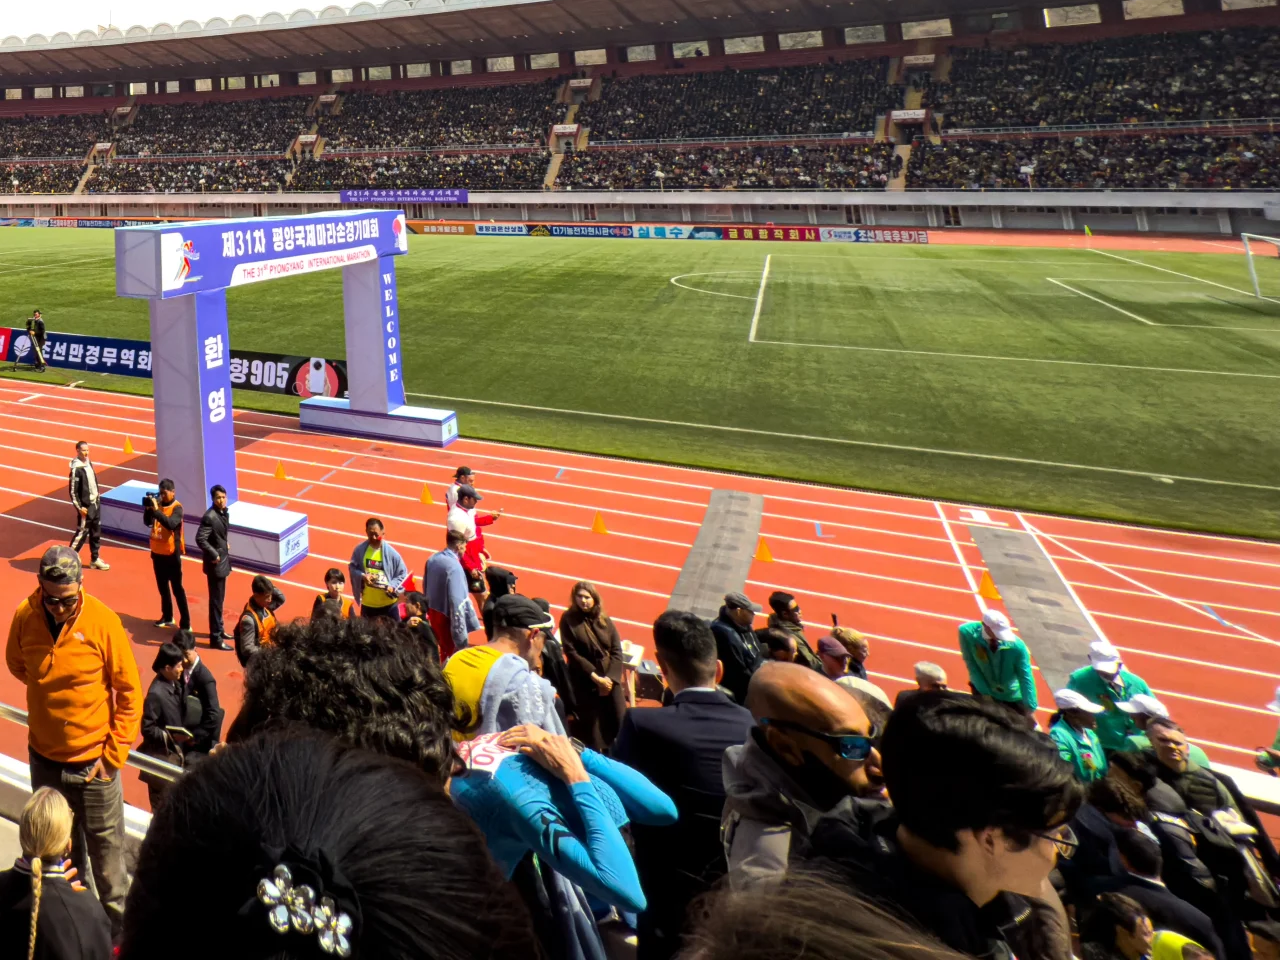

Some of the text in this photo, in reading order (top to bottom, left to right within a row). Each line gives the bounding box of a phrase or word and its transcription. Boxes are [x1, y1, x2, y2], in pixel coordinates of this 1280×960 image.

[222, 217, 380, 258] 제31차 평양국제마라손경기대회
[243, 266, 256, 279] THE
[269, 261, 305, 274] PYONGYANG
[308, 255, 346, 268] INTERNATIONAL
[346, 249, 371, 262] MARATHON
[383, 273, 398, 382] WELCOME
